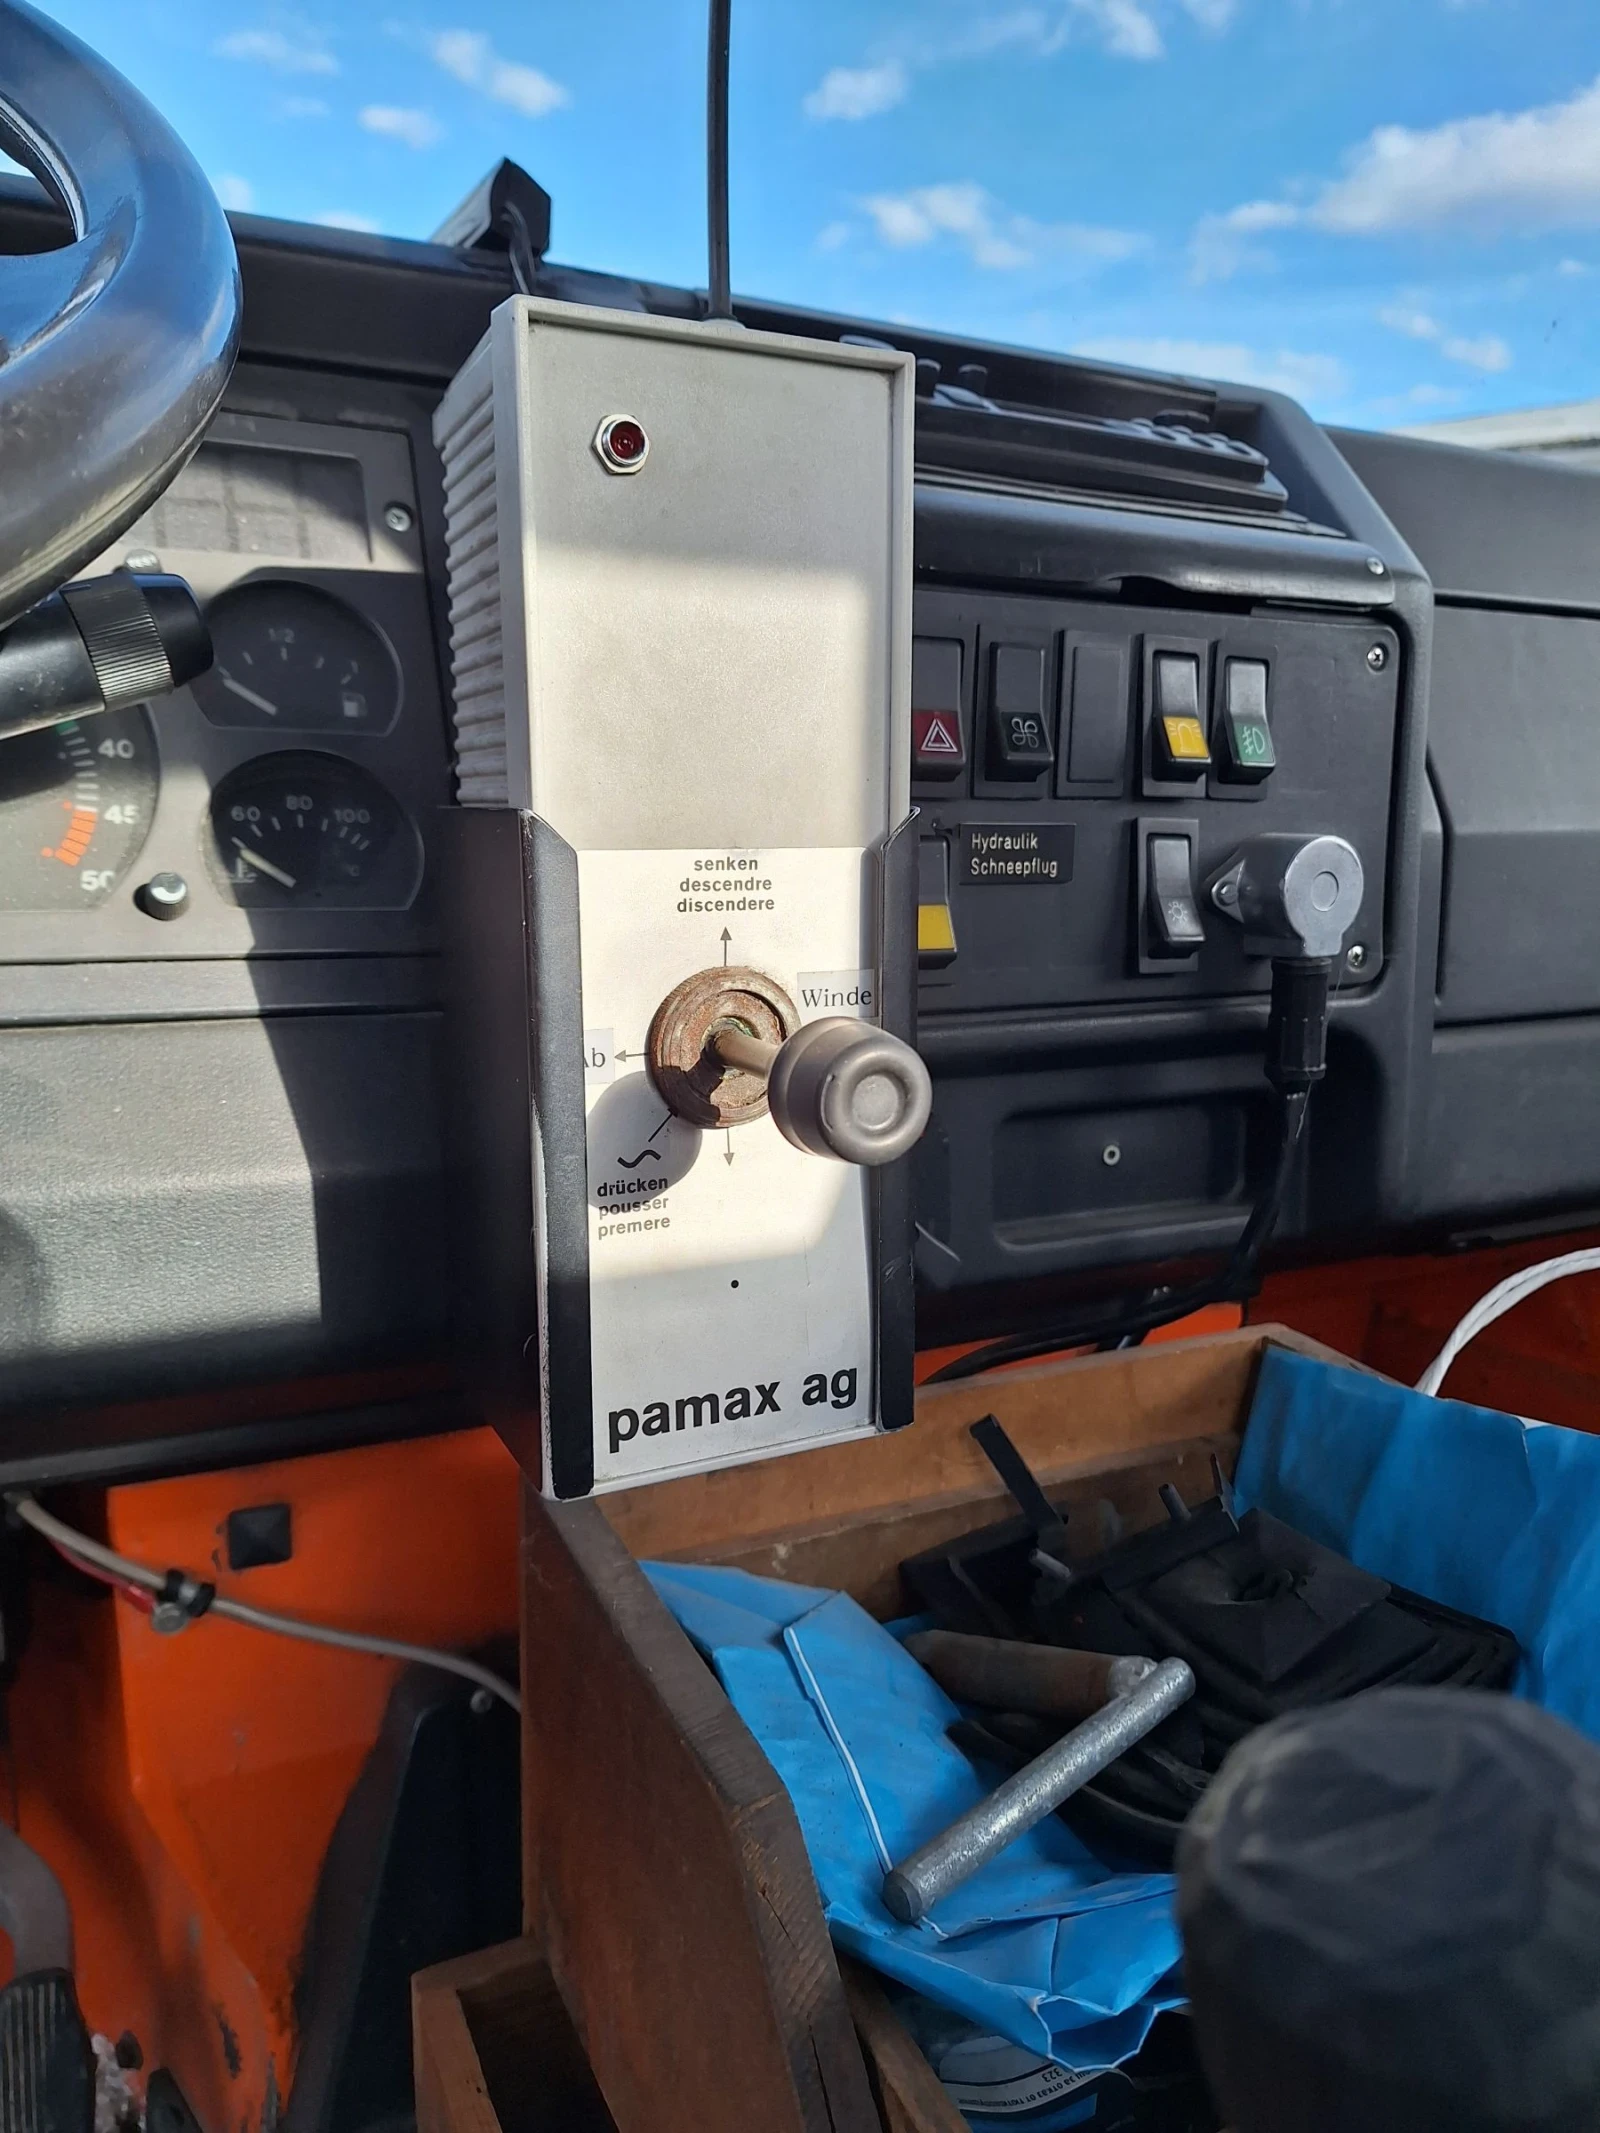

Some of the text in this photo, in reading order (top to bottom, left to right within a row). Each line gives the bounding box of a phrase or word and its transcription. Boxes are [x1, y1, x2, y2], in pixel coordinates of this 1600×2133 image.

[98, 738, 135, 759] 40
[231, 805, 261, 822] 60
[286, 795, 313, 811] 80
[104, 804, 139, 825] 45
[334, 808, 371, 824] 100
[971, 832, 1039, 855] Hydraulik
[693, 856, 759, 872] senken
[970, 856, 1058, 878] Schneepflug
[679, 876, 773, 892] descendre
[676, 896, 775, 913] discendere
[801, 986, 873, 1008] Winde
[597, 1177, 669, 1197] drücken
[598, 1197, 670, 1221] pousser
[598, 1217, 671, 1241] premere
[608, 1367, 858, 1454] pamax ag
